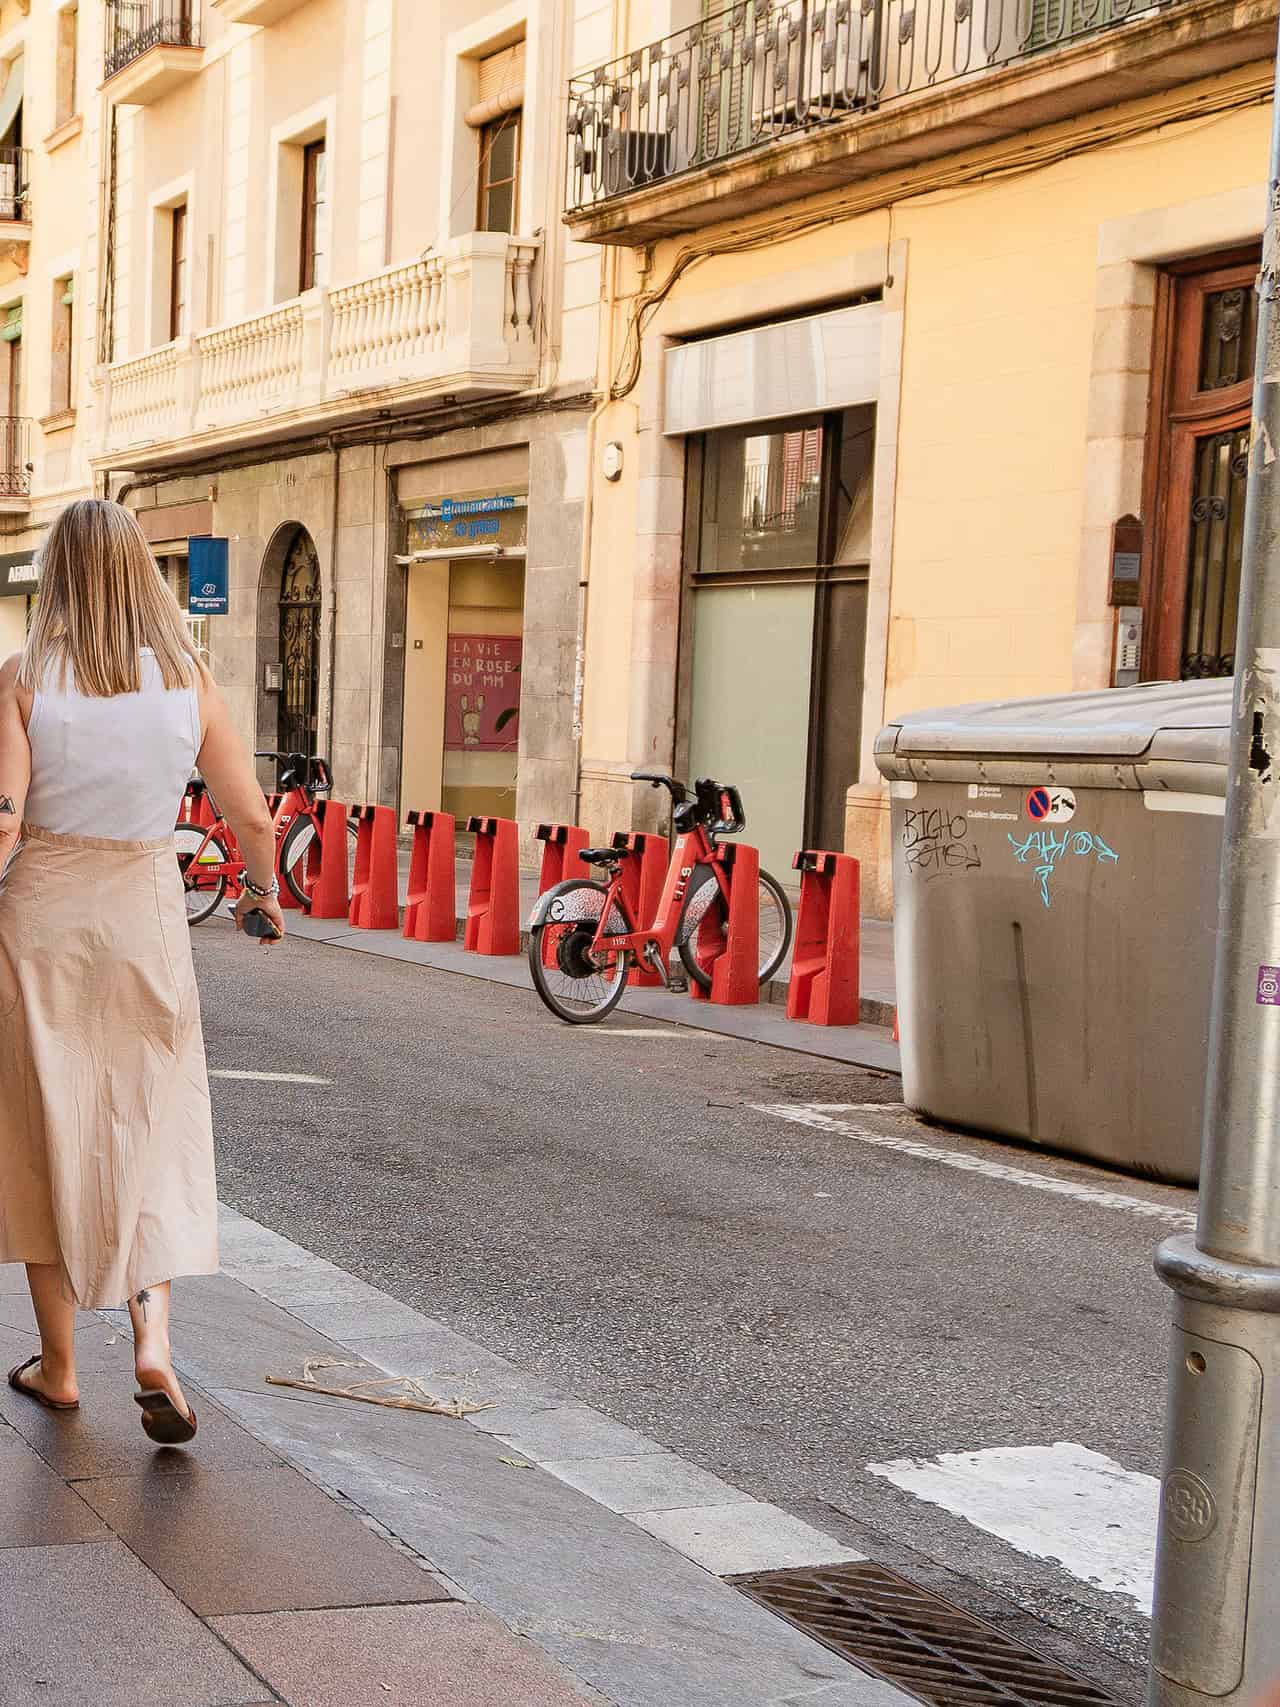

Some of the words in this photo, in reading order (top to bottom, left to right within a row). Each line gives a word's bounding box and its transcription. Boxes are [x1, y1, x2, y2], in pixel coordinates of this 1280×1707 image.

[454, 641, 470, 653] LA
[454, 657, 470, 668] EN
[475, 658, 512, 673] ROSE
[453, 673, 472, 686] DU
[482, 674, 504, 688] MM
